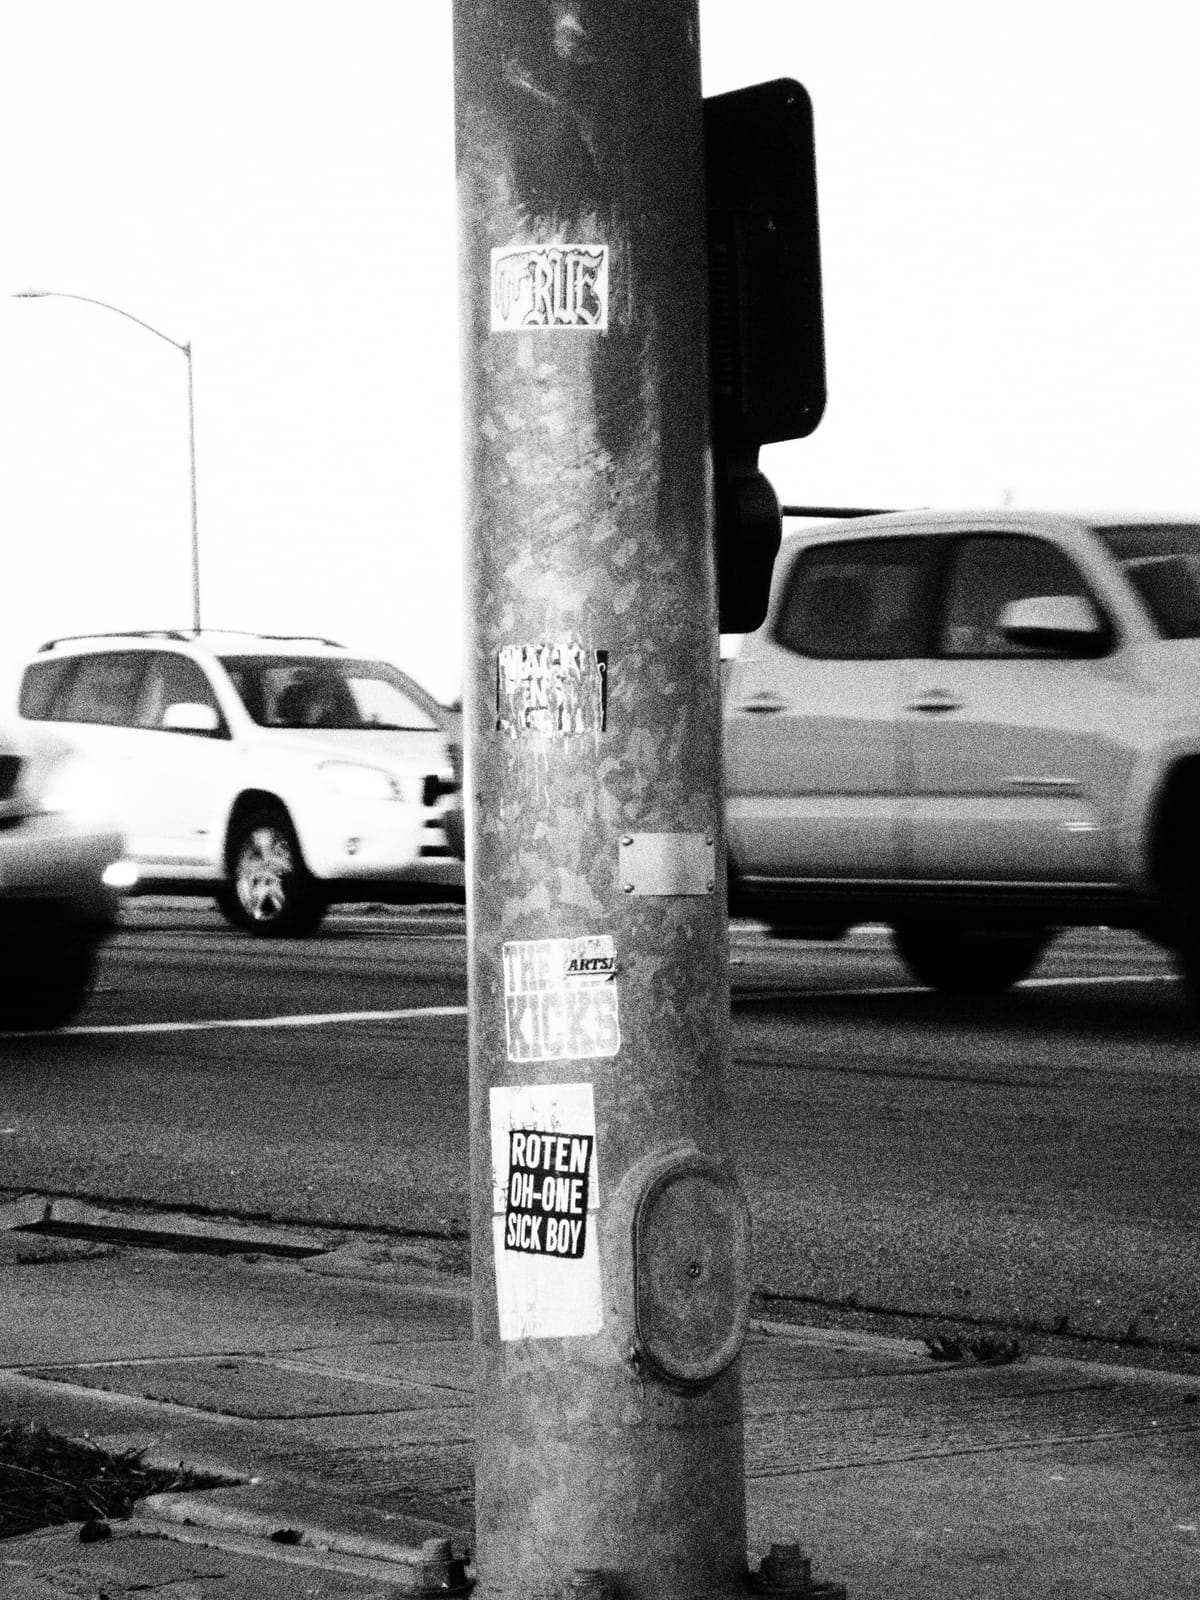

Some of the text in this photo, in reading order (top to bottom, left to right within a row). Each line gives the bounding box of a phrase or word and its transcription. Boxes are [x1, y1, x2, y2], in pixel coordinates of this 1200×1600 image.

[506, 990, 618, 1059] KICKS
[511, 1133, 589, 1174] ROTEN
[510, 1172, 584, 1214] OH-ONE
[507, 1212, 583, 1254] SICK BOY
